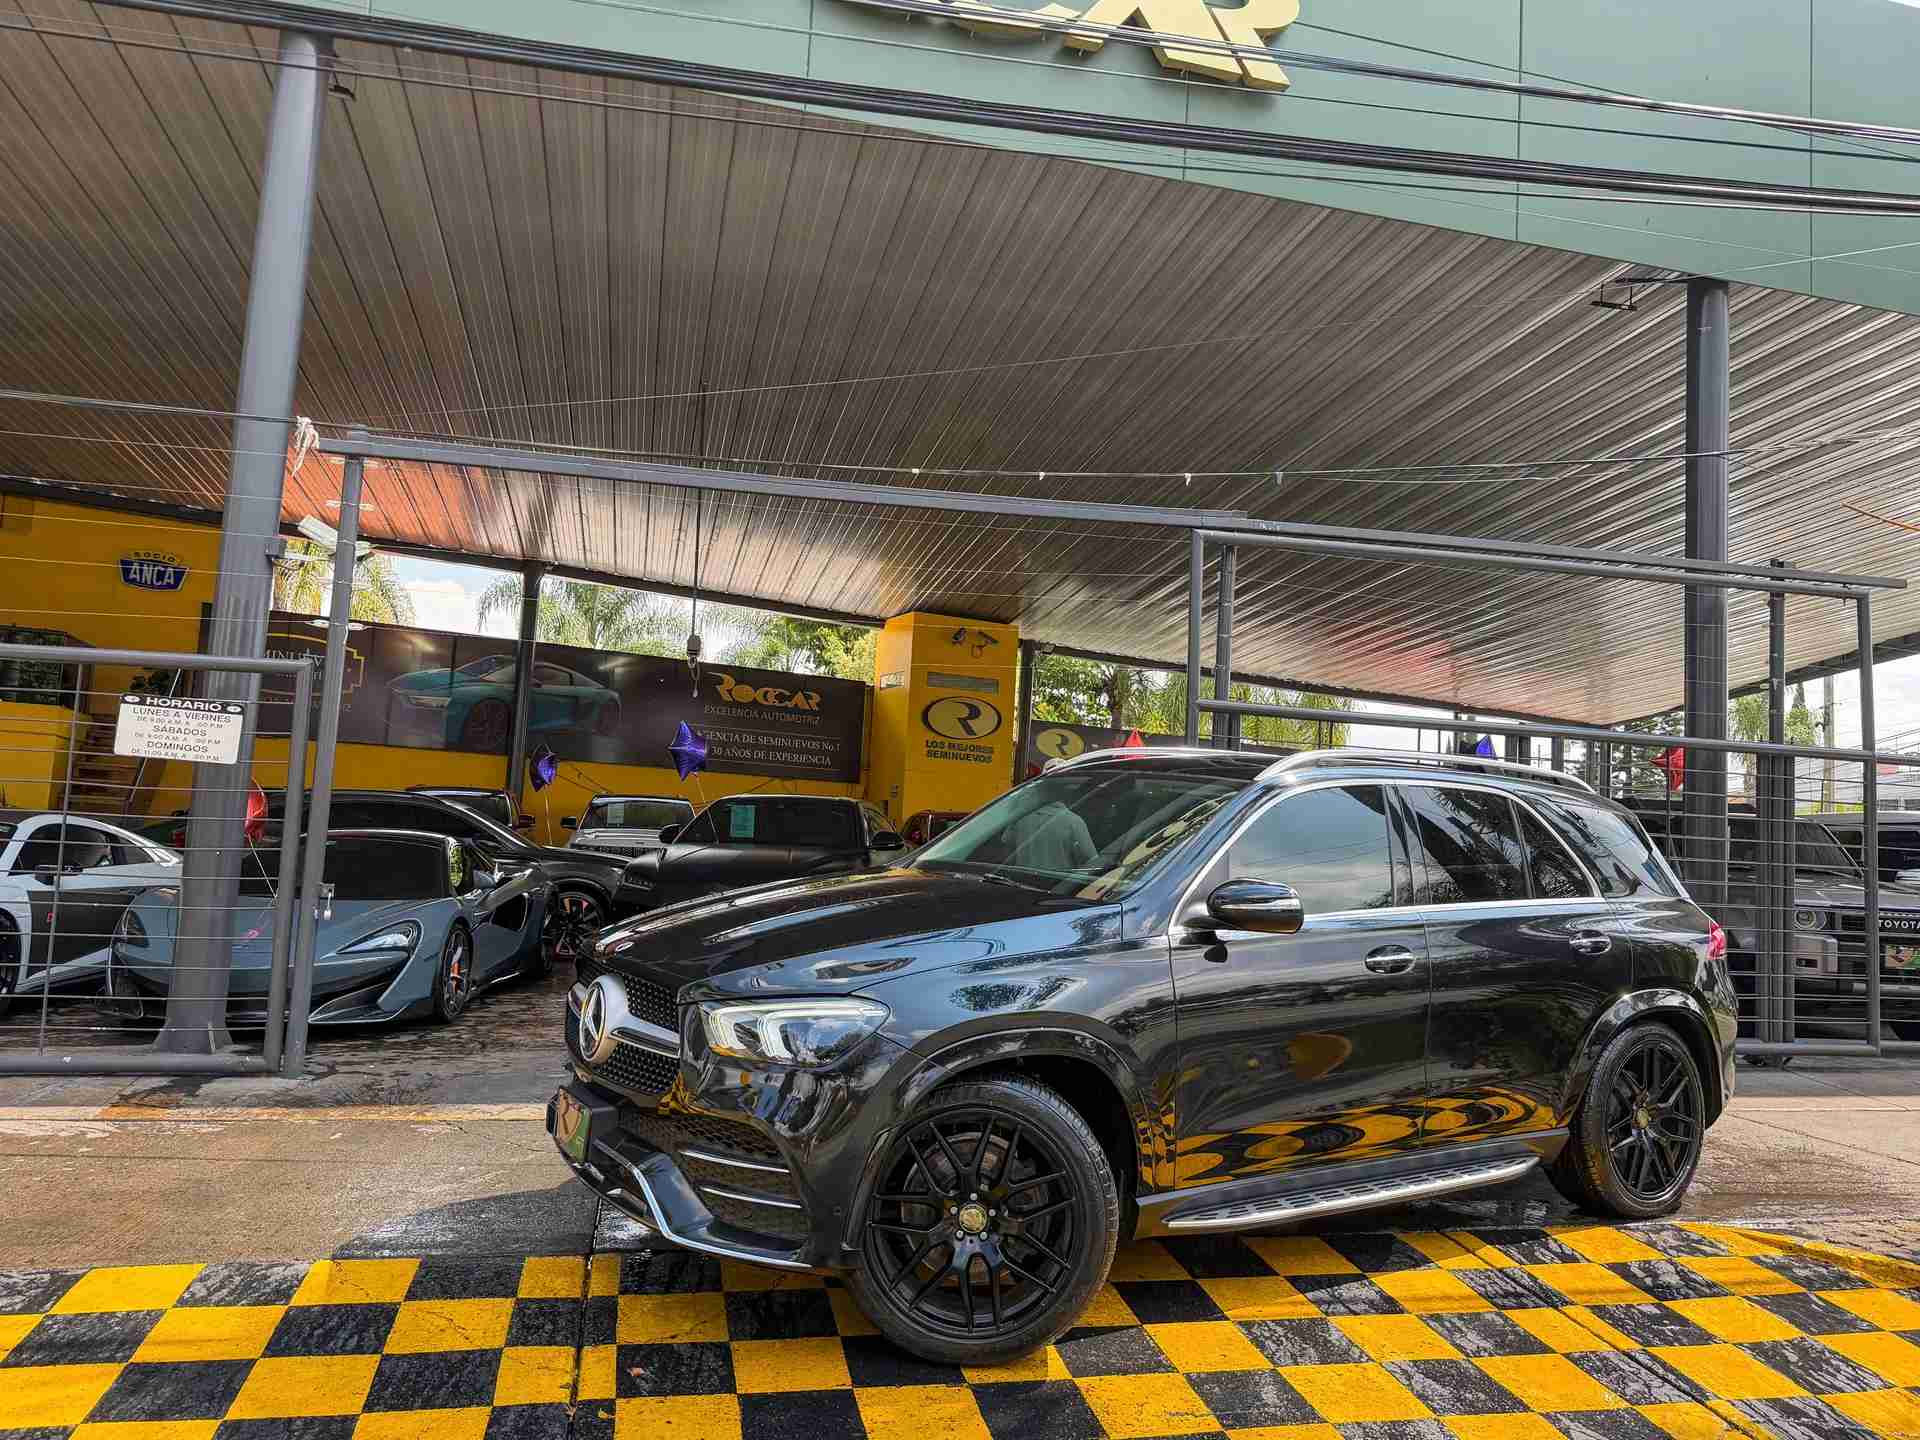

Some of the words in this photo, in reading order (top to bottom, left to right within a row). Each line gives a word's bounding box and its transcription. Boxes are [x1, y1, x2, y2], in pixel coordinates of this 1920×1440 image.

[129, 562, 175, 586] ANCA
[146, 696, 222, 712] HORARIO
[704, 704, 761, 719] EXCELENCIA
[133, 706, 169, 718] LUNES
[173, 710, 181, 719] A
[184, 712, 232, 724] VIERNES
[146, 740, 209, 753] DOMINGOS
[742, 734, 756, 744] DE
[758, 735, 821, 750] SEMINUEVOS
[926, 740, 945, 749] LOS
[947, 742, 993, 754] MEJORES
[753, 751, 767, 761] DE
[769, 751, 832, 767] EXPERIENCIA
[927, 750, 993, 764] SEMINUEVOS
